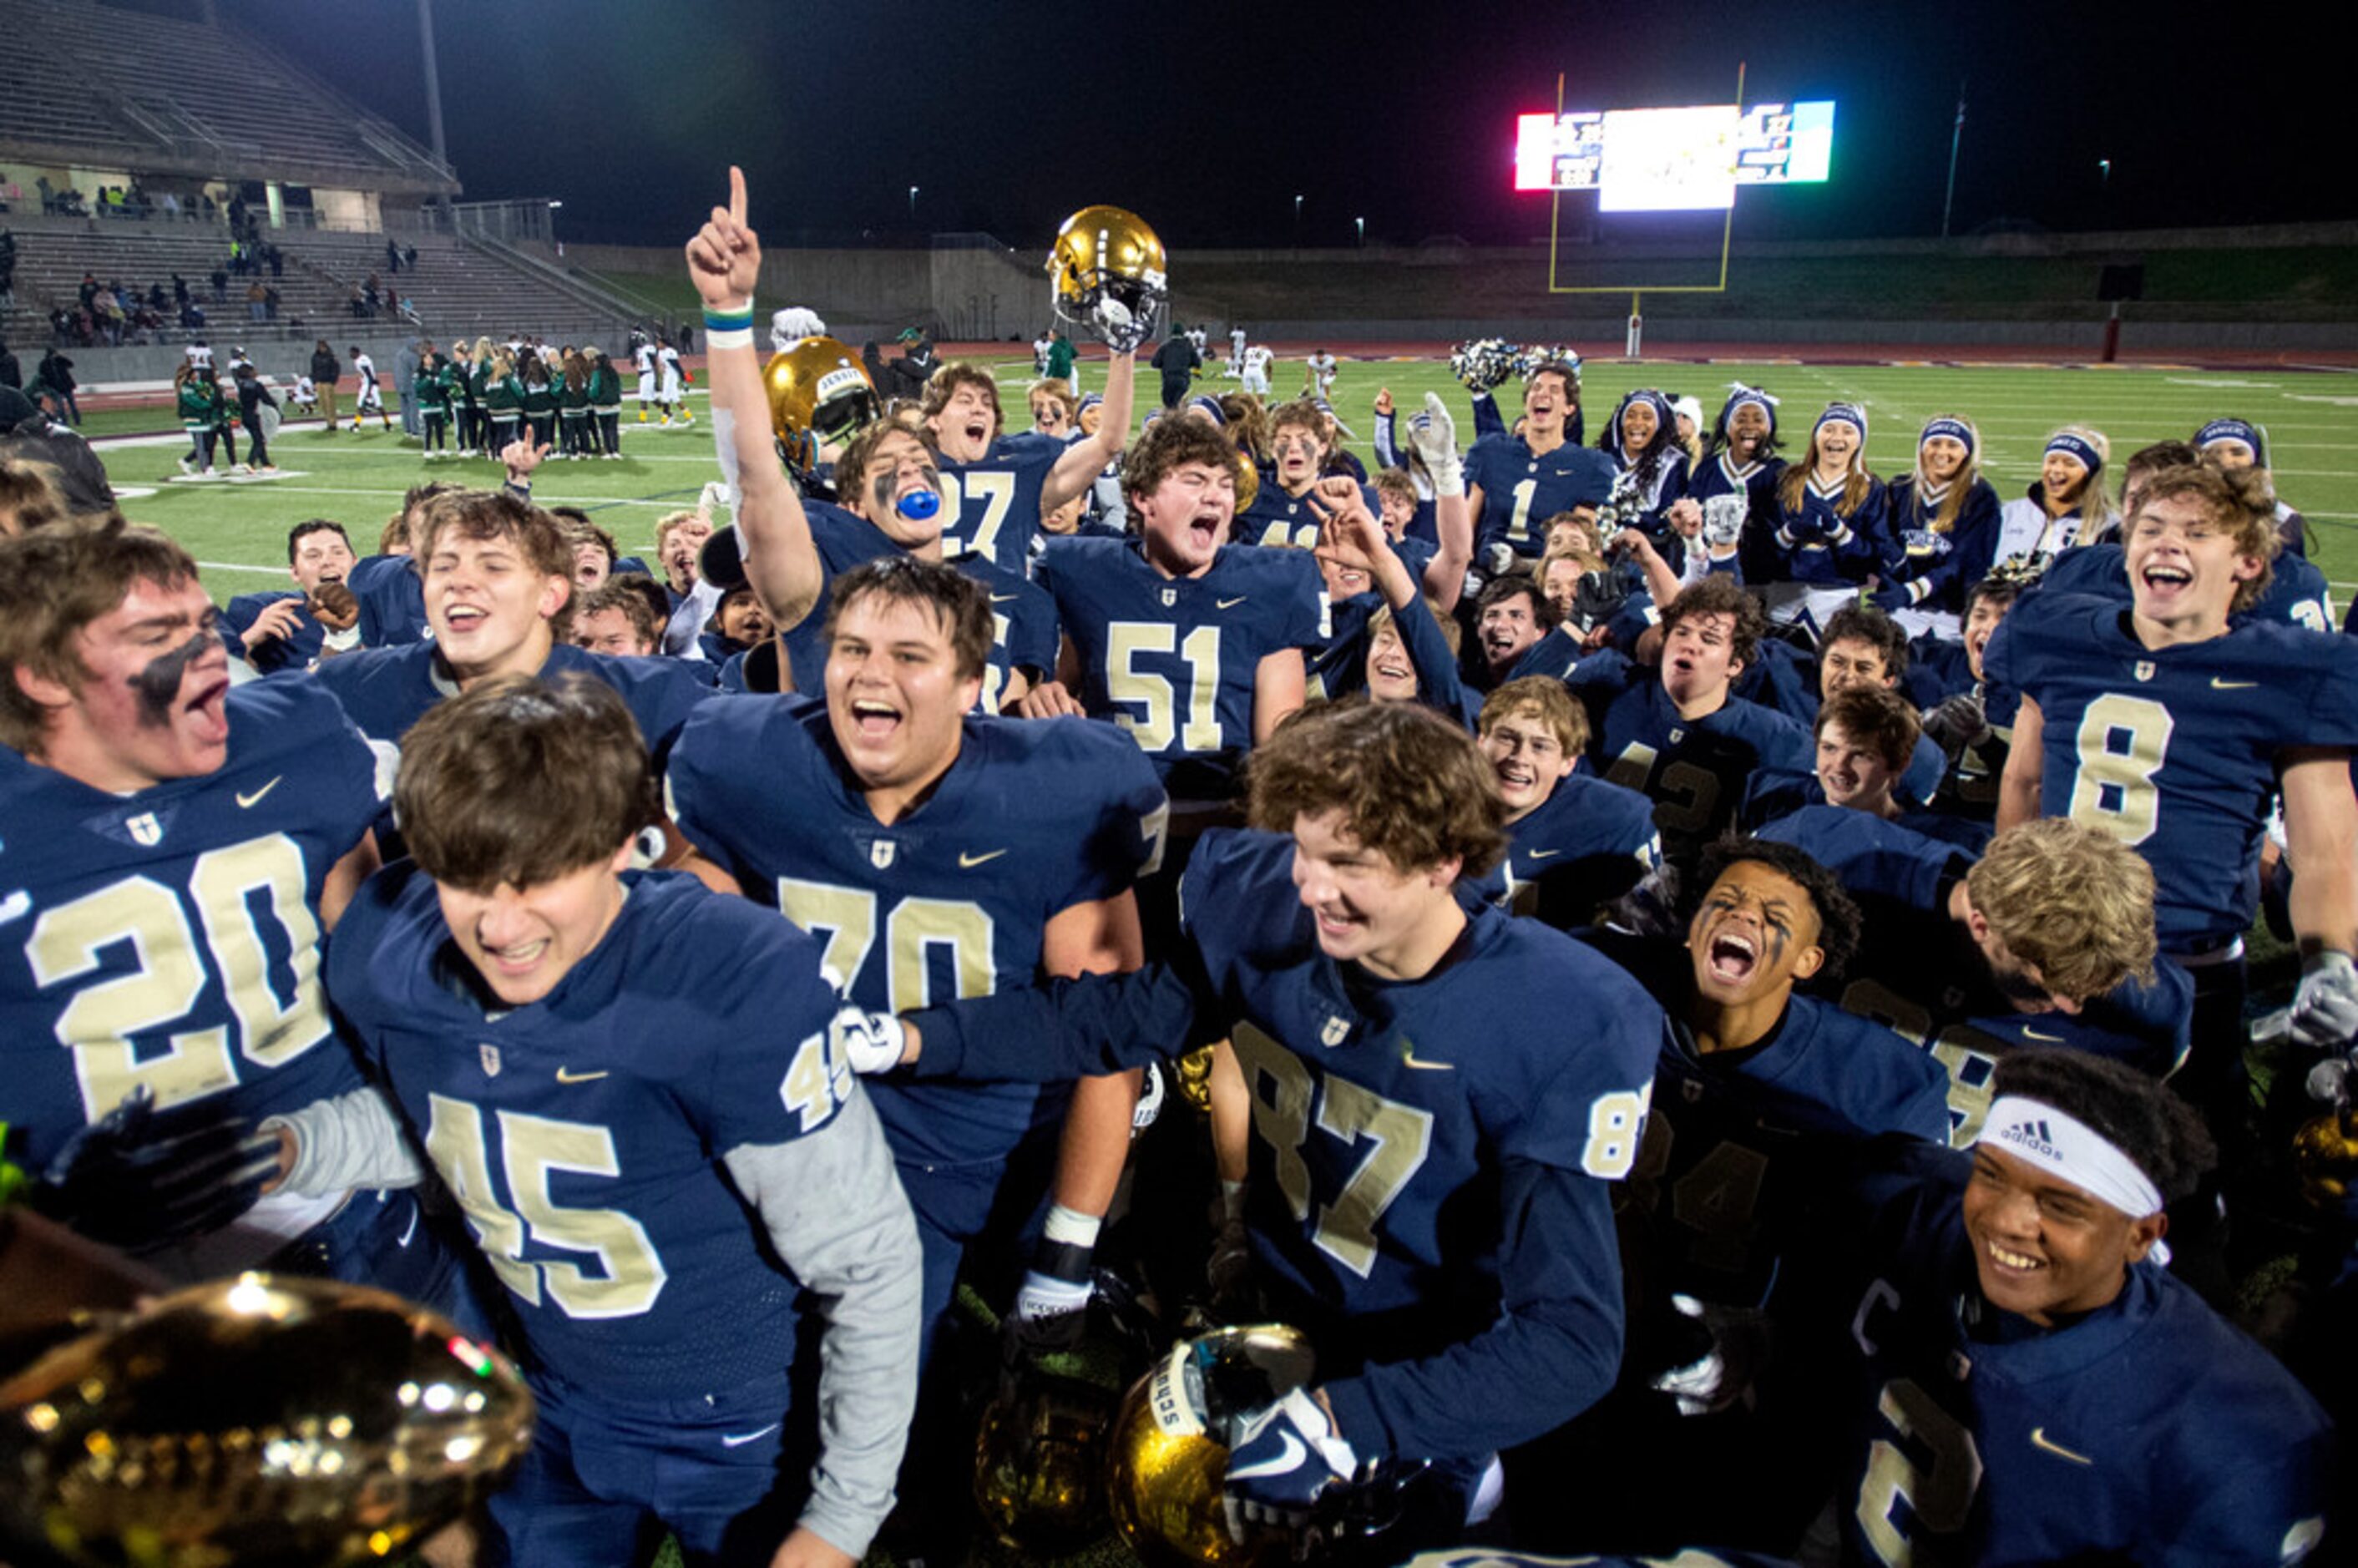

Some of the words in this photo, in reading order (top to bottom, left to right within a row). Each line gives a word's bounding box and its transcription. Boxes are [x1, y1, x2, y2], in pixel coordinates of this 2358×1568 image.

[937, 471, 1015, 564] 27
[1505, 478, 1537, 541] 1
[1106, 621, 1223, 752] 51
[2068, 692, 2174, 845] 8
[1140, 792, 1171, 878] 7
[24, 832, 333, 1125] 20
[777, 878, 995, 1014] 70
[1232, 1019, 1434, 1279] 87
[1581, 1077, 1654, 1180] 8
[2001, 1129, 2064, 1161] adidas
[1851, 1277, 1900, 1356] C
[1154, 1359, 1181, 1426] schu
